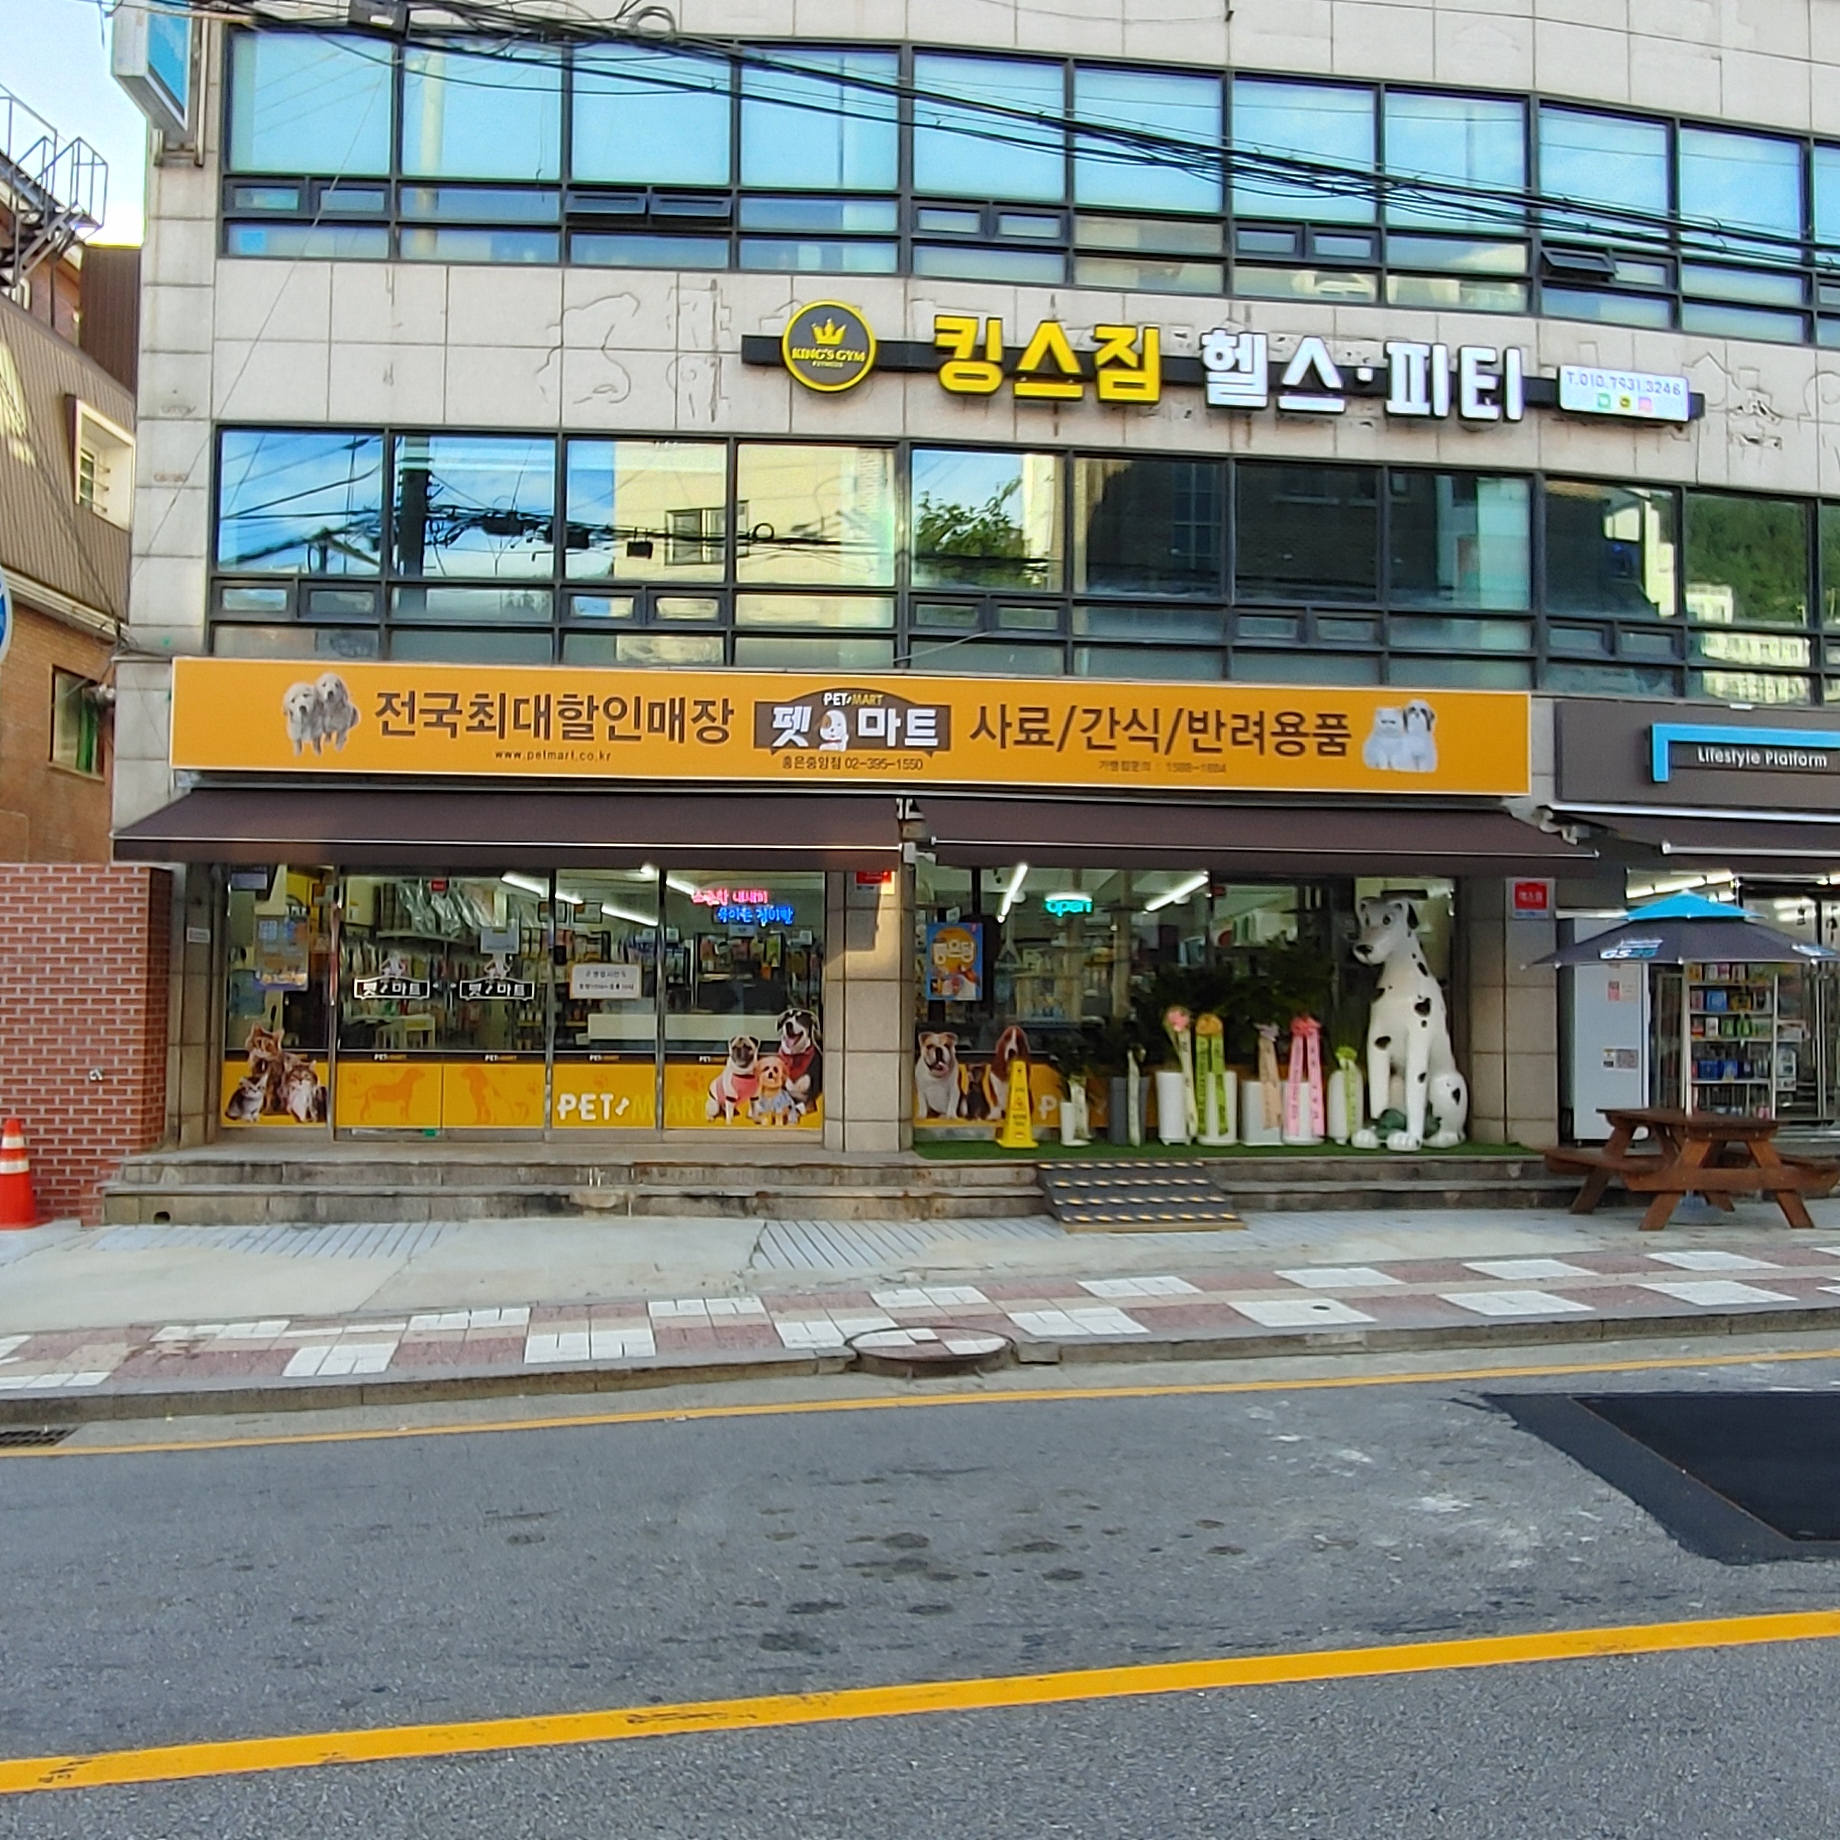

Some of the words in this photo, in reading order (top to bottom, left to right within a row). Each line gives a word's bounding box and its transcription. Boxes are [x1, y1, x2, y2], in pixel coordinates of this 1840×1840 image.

[934, 314, 1162, 403] 킹스짐
[374, 689, 735, 746] 전국최대할인매장
[494, 749, 612, 764] www.petmart.co.kr
[1697, 746, 1761, 768] Lifestyle
[1765, 750, 1827, 768] Platform
[1045, 900, 1093, 917] open
[557, 1092, 615, 1122] PET
